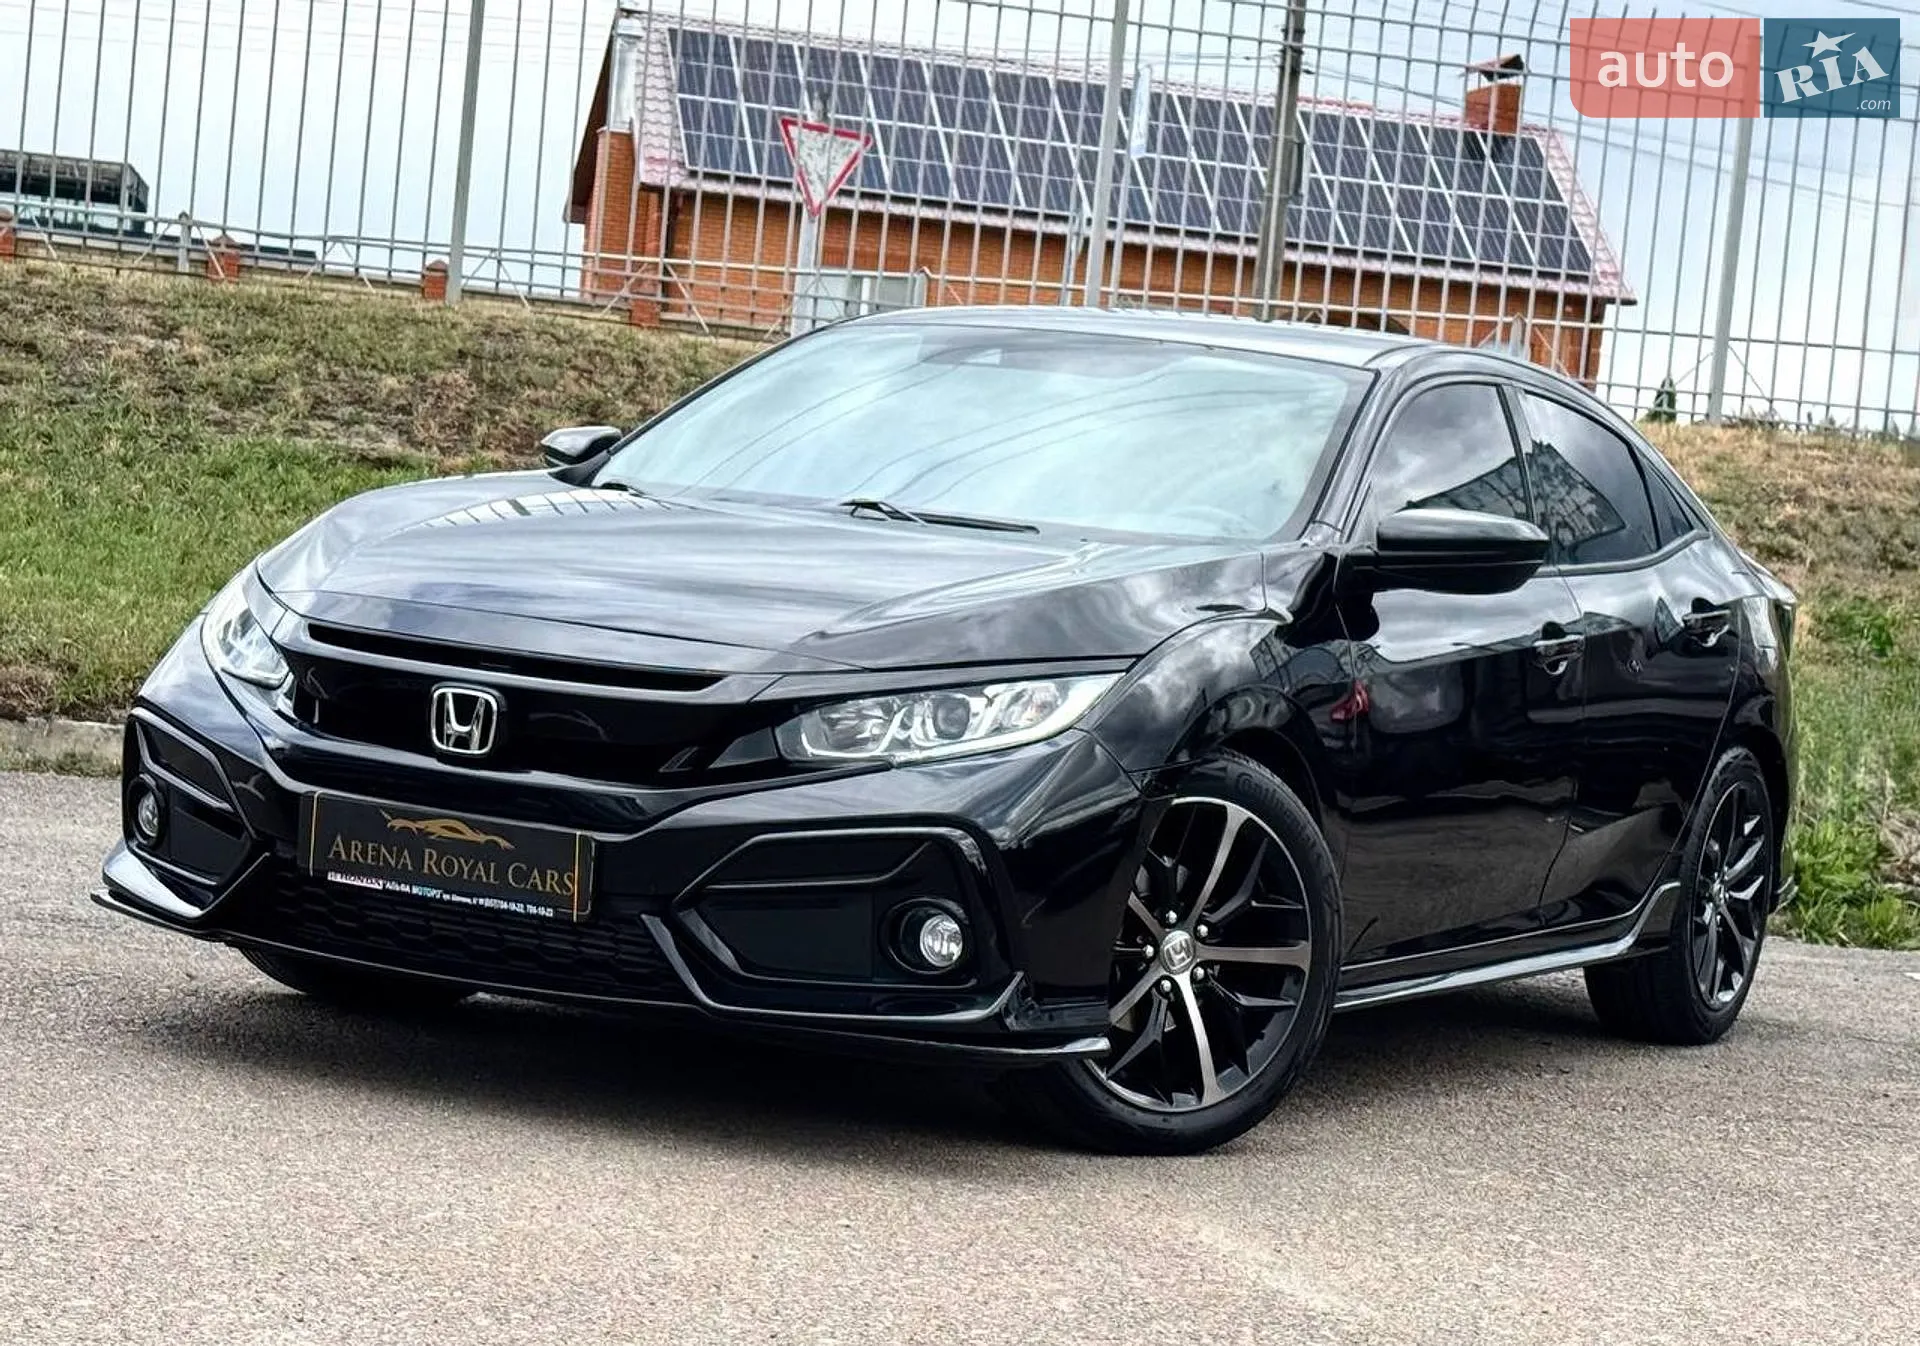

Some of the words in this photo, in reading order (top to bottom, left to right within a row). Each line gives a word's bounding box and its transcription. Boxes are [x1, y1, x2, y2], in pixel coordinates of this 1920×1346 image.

[327, 832, 414, 871] ARENA
[423, 848, 500, 886] ROYAL
[507, 862, 575, 897] CARS
